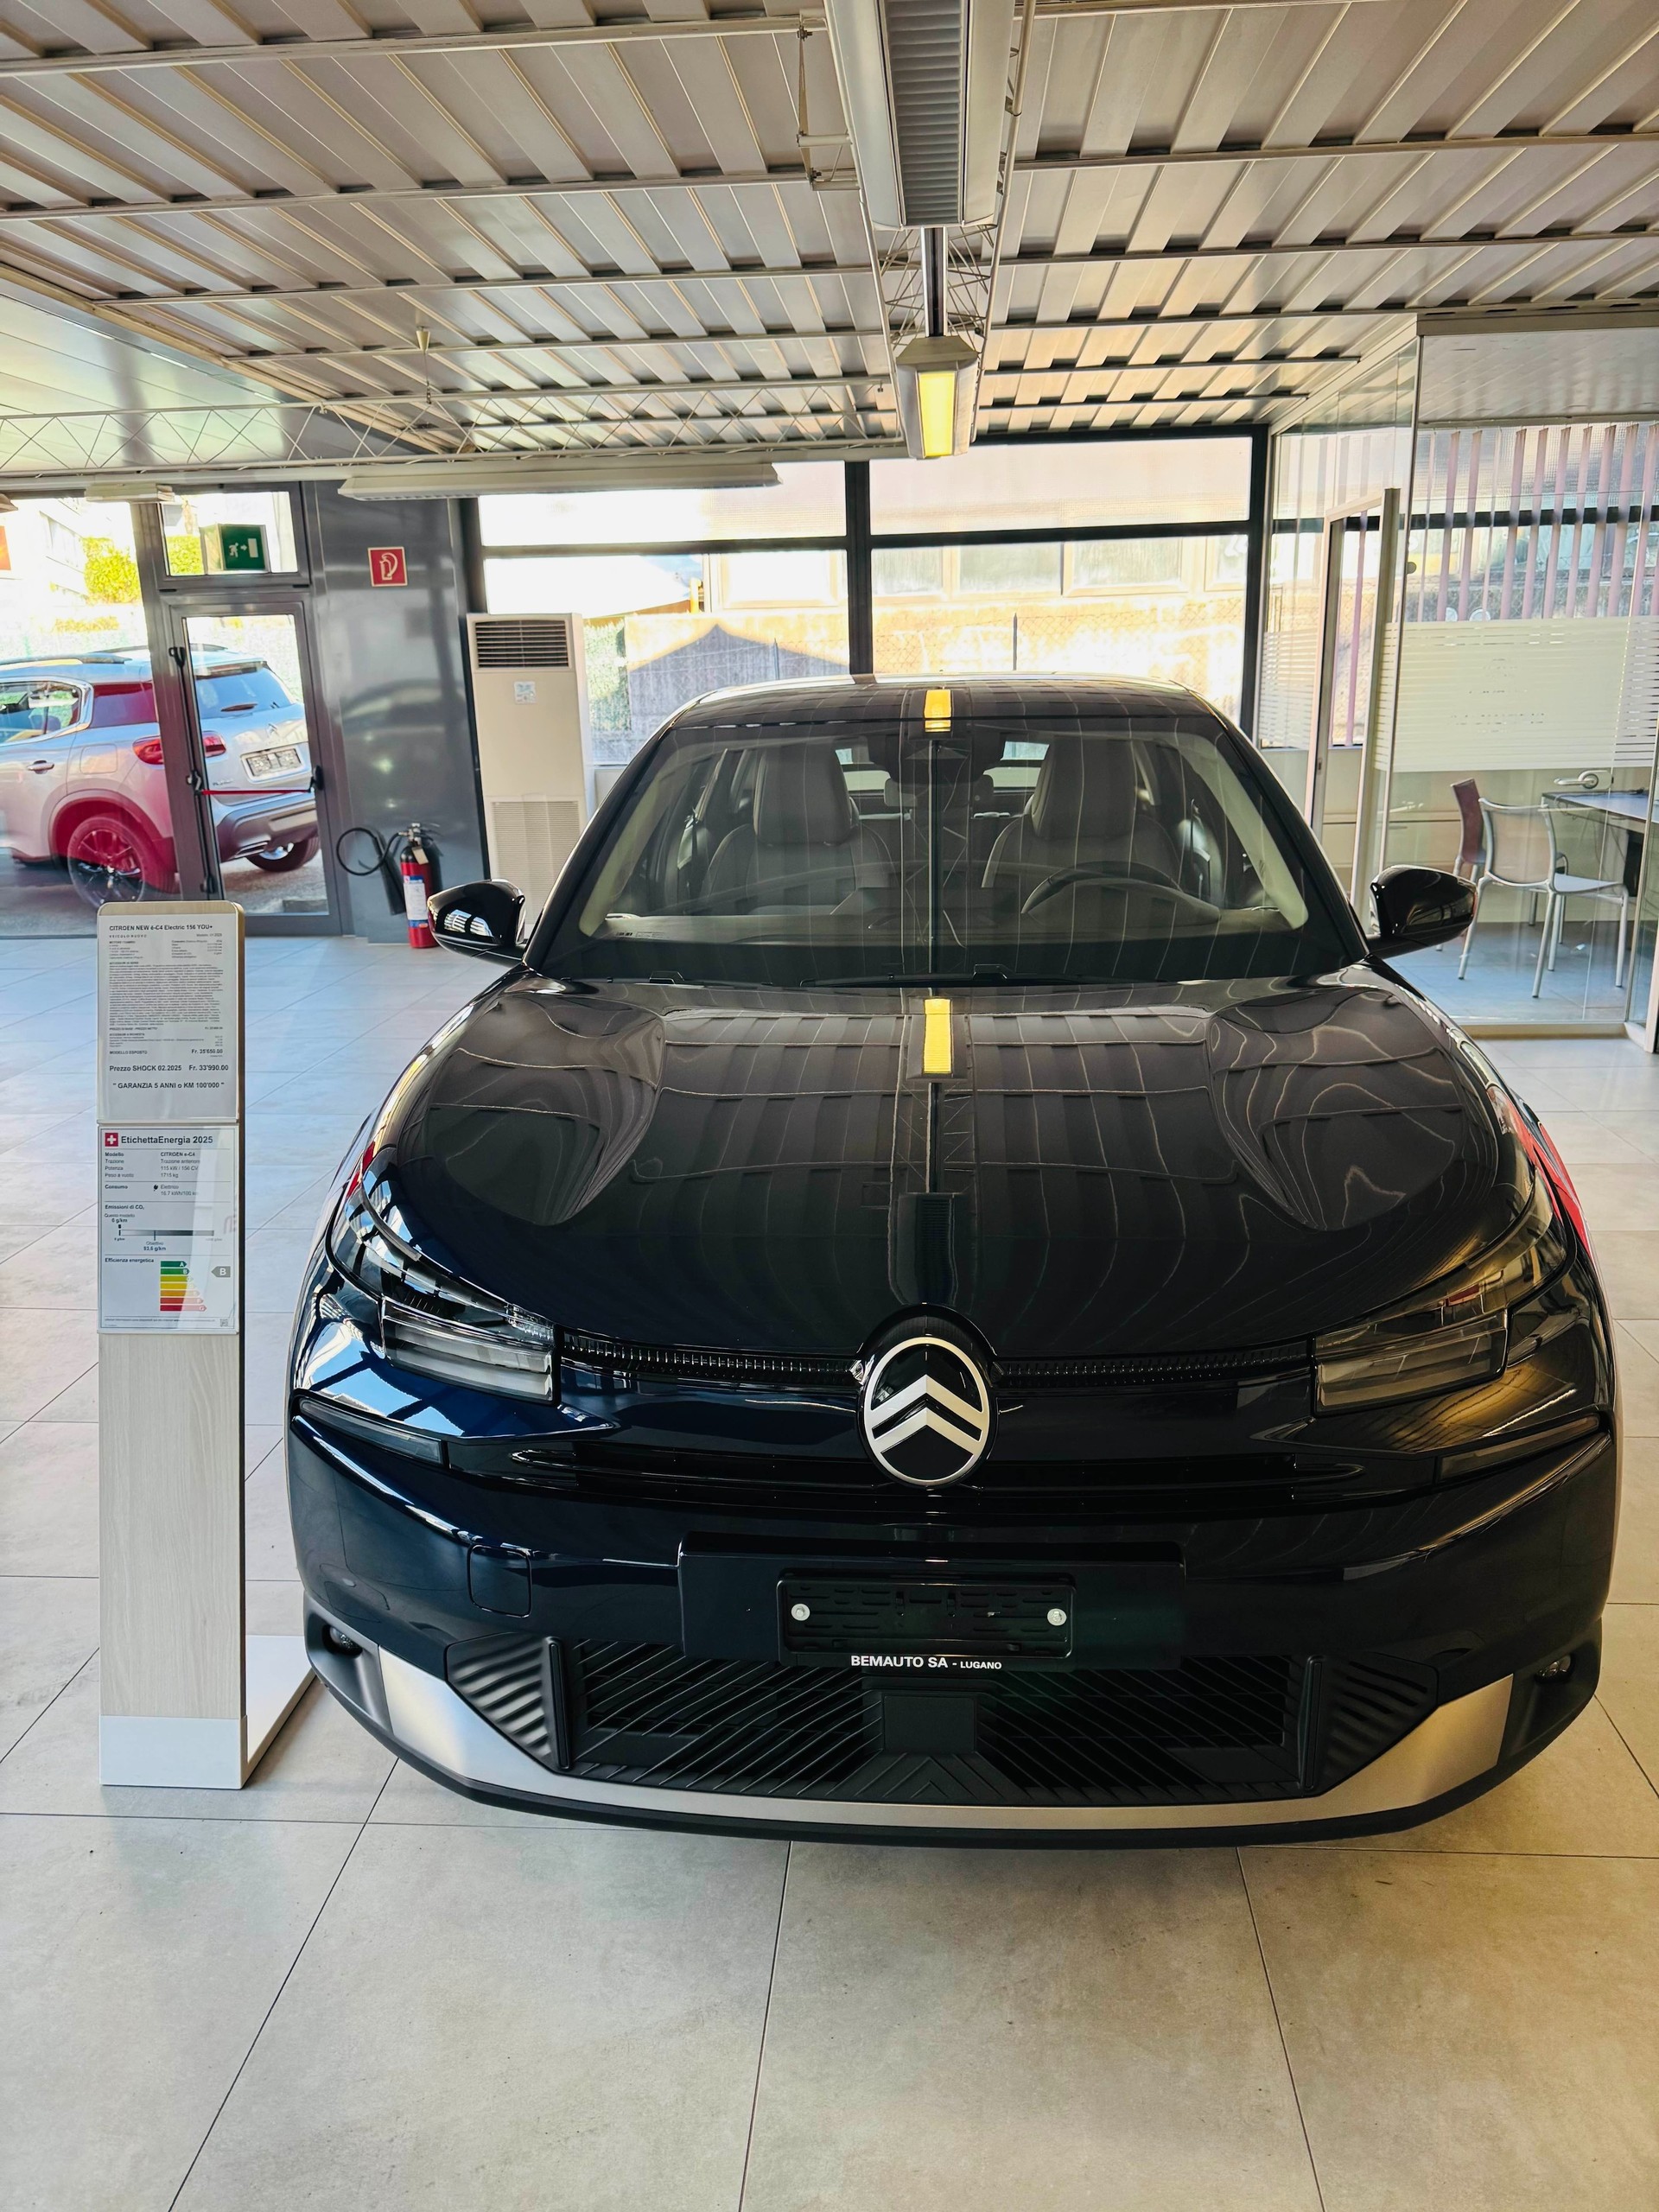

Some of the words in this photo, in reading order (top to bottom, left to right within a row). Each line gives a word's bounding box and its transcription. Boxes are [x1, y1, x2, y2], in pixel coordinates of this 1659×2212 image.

[121, 1136, 191, 1145] EtichettaEnergia
[850, 1656, 924, 1668] BEMAUTO
[927, 1656, 948, 1669] SA
[960, 1661, 1002, 1669] LUGANO
